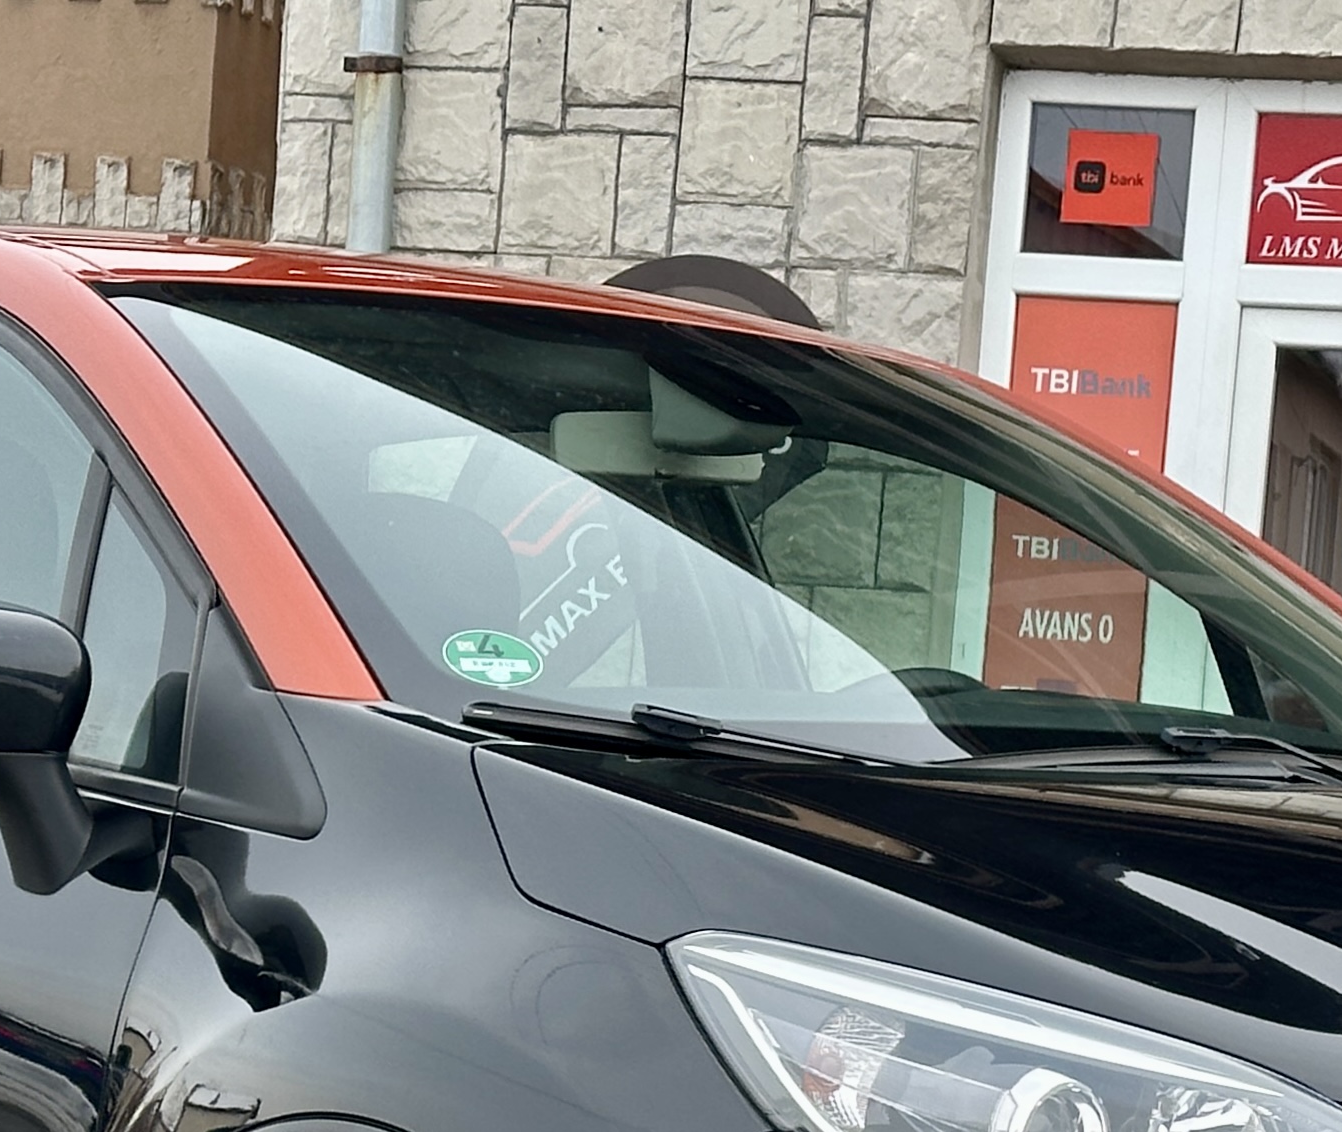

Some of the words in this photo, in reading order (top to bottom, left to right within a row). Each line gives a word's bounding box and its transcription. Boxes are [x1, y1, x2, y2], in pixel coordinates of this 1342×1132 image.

[1109, 171, 1144, 188] bank
[1259, 236, 1322, 259] LMS
[530, 576, 611, 656] MAX
[1018, 607, 1092, 642] AVANS
